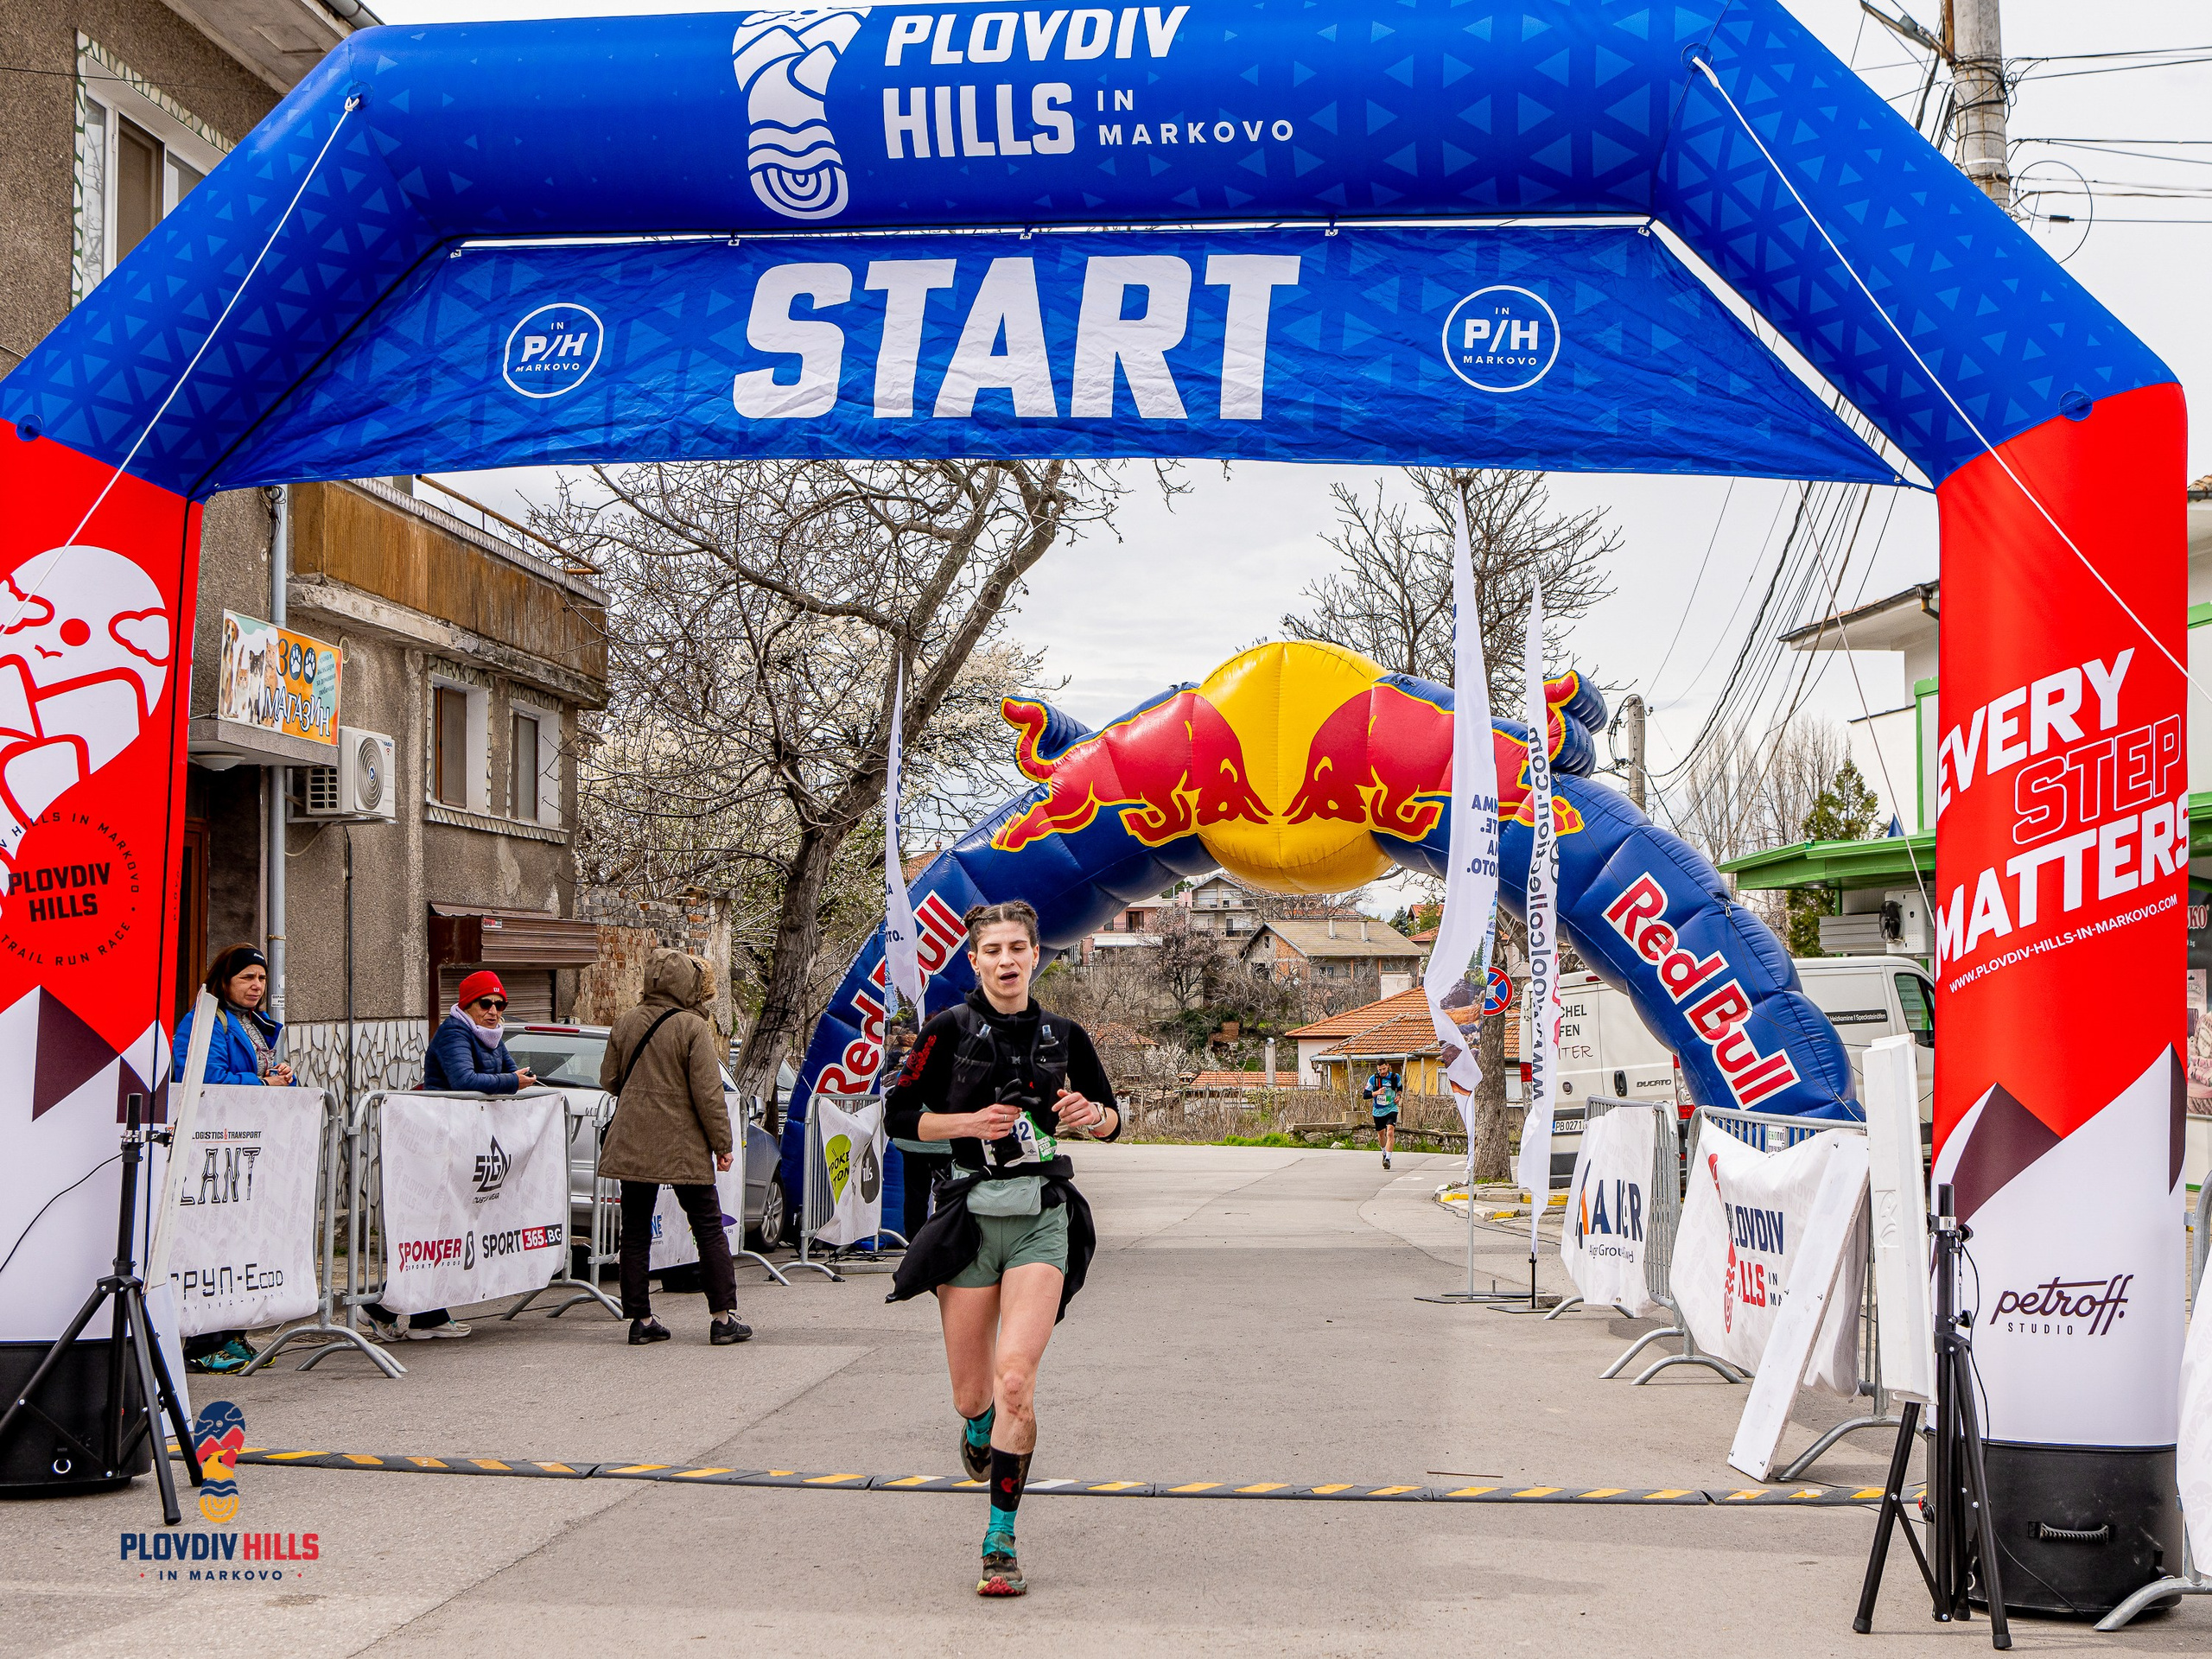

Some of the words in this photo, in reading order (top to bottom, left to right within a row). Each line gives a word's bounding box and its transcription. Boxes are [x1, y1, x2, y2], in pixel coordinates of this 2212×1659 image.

[884, 5, 1191, 67] PLOVDIV
[1096, 89, 1134, 111] IN
[882, 82, 1076, 159] HILLS
[1097, 119, 1294, 146] MARKOVO
[550, 321, 564, 331] IN
[1495, 307, 1510, 315] IN
[520, 332, 588, 363] P/H
[733, 255, 1301, 420] START
[1464, 319, 1539, 353] P/H
[515, 363, 581, 372] MARKOVO
[1463, 355, 1537, 365] MARKOVO
[264, 686, 330, 736] МАГАЗИН
[1937, 647, 2135, 822] EVERY
[2012, 714, 2181, 845] STEP
[11, 812, 60, 836] HILLS
[72, 813, 90, 825] IN
[98, 823, 139, 893] MARKOVO
[8, 862, 111, 895] PLOVDIV
[1936, 788, 2189, 982] MATTERS
[29, 893, 99, 922] HILLS
[1, 934, 43, 964] TRAIL
[55, 953, 90, 966] RUN
[98, 922, 130, 956] RACE
[1949, 893, 2178, 994] WWW.PLOVDIV-HILLS-IN-MARKOVO.COM
[1603, 872, 1729, 1004] Red
[1683, 978, 1801, 1110] Bull
[814, 988, 886, 1096] Red
[1636, 1078, 1672, 1088] DUCATO
[228, 1130, 262, 1139] TRANSPORT
[398, 1238, 462, 1273] SPONSER
[2007, 1322, 2074, 1336] STUDIO
